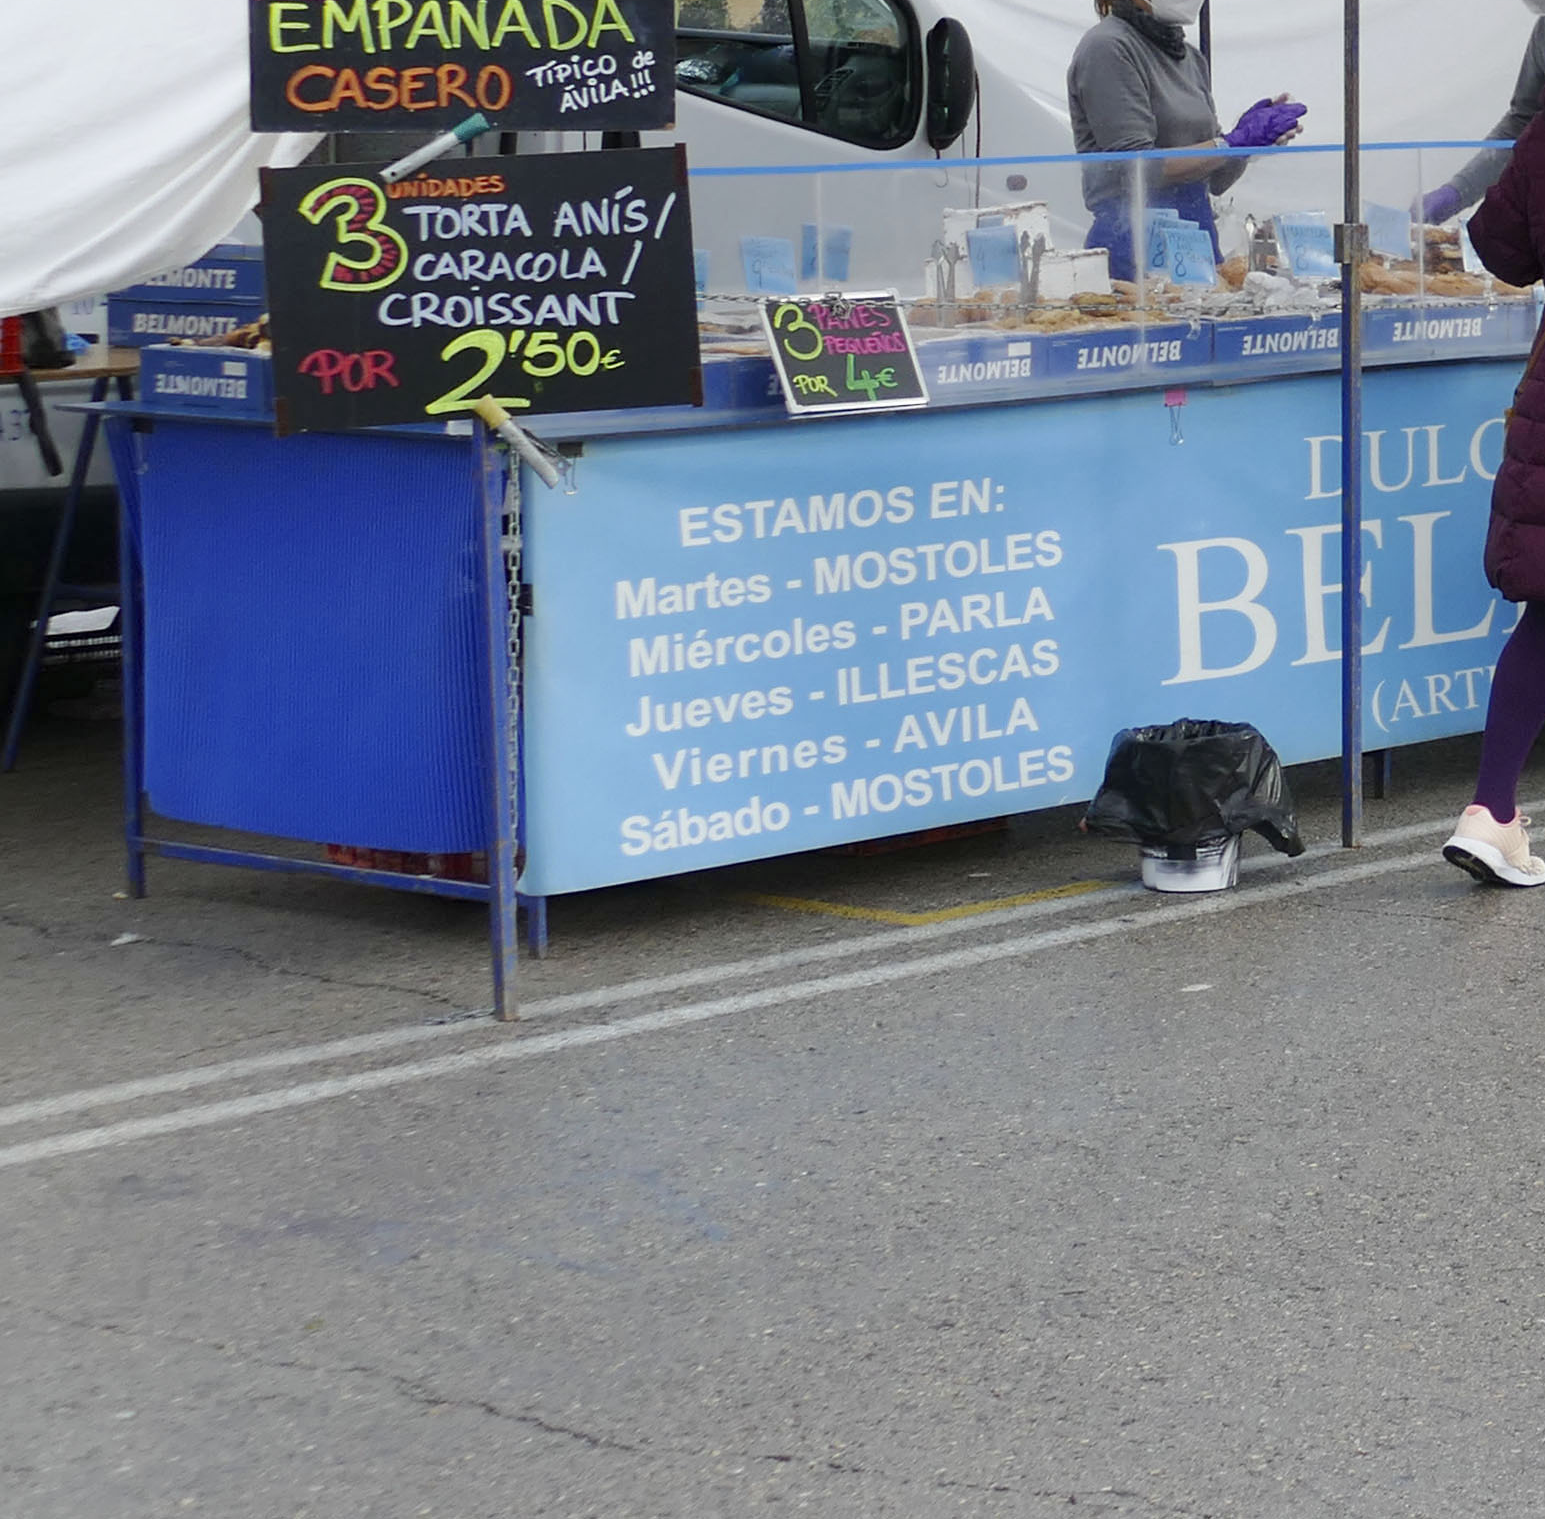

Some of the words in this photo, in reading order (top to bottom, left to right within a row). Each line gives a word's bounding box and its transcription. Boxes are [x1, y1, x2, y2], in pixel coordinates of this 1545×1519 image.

[631, 50, 656, 70] de
[286, 61, 513, 113] CASERO
[386, 174, 507, 200] UNIDADES
[298, 177, 409, 293] 3
[402, 203, 533, 243] TORTA
[412, 247, 607, 282] CARACOLA
[132, 312, 238, 337] BELMONTE
[378, 286, 637, 329] CROISSANT
[773, 302, 825, 361] 3
[822, 331, 908, 357] PEQUEÑOS
[1241, 325, 1340, 357] BELMONTE
[1393, 316, 1483, 343] BELMONTE
[297, 347, 401, 395] POR
[936, 358, 1032, 385] BELMONTE
[1077, 339, 1183, 370] BELMONTE
[155, 373, 249, 400] BELMONTE
[792, 374, 839, 398] POR
[845, 353, 899, 402] 4€
[1303, 418, 1505, 501] DULC
[679, 485, 915, 548] ESTAMOS
[929, 477, 1006, 521] EN:
[614, 573, 772, 620] Martes
[813, 529, 1064, 596] MOSTOLES
[629, 618, 857, 678] Miércoles
[900, 586, 1055, 641] PARLA
[625, 684, 793, 738] Jueves
[837, 638, 1061, 706] ILLESCAS
[652, 733, 848, 791] Viernes
[893, 696, 1040, 754] AVILA
[619, 795, 791, 857] Sábado
[831, 744, 1075, 820] MOSTOLES
